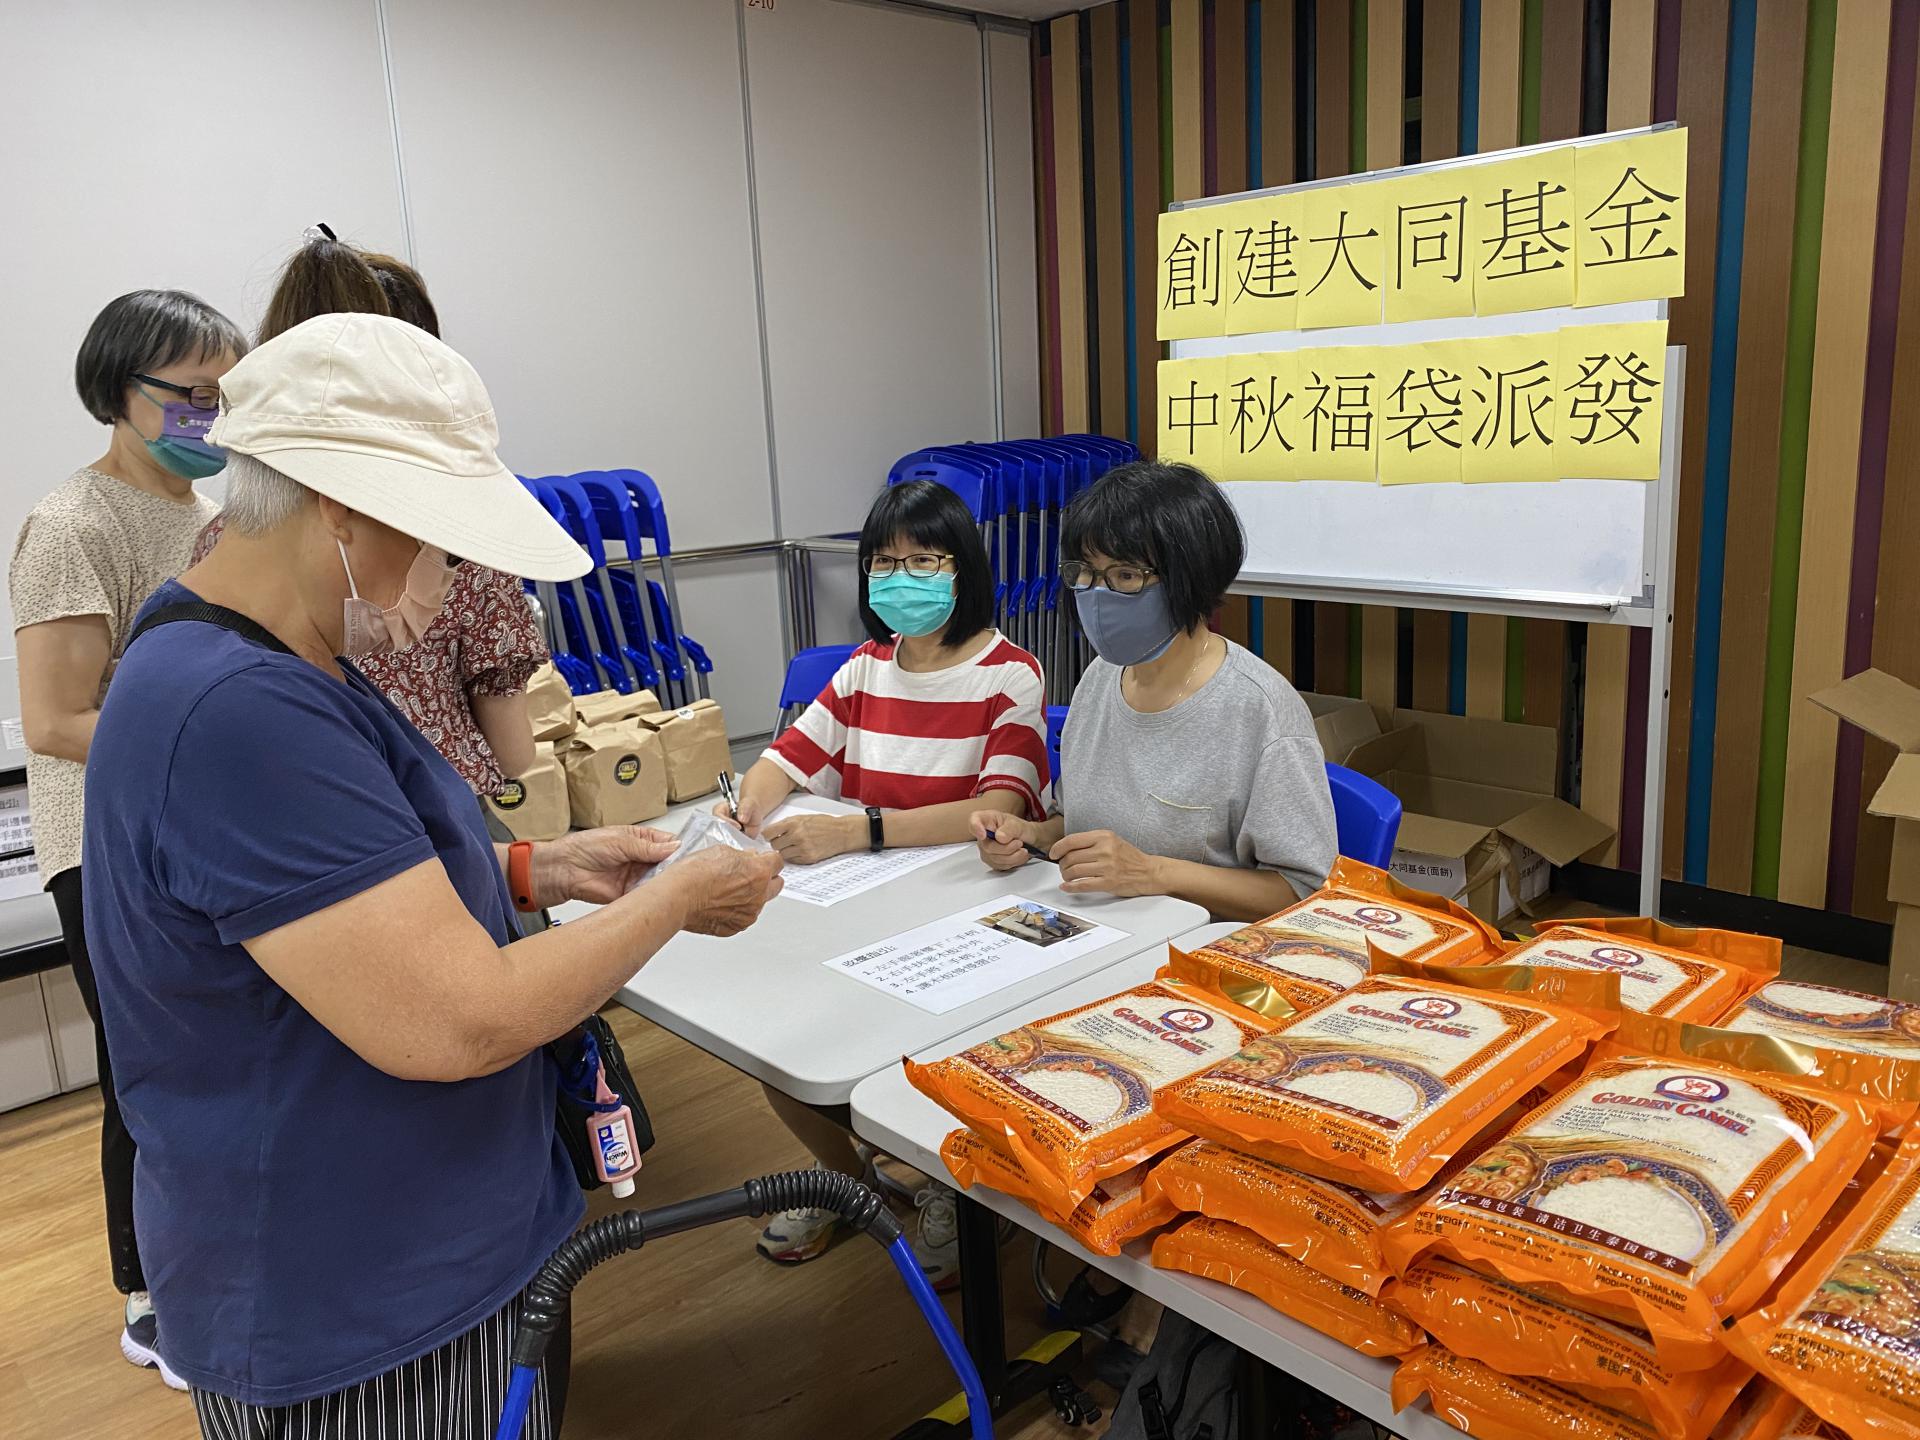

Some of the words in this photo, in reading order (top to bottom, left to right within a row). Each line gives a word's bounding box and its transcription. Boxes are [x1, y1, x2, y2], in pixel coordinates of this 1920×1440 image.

[1163, 166, 1680, 311] 創建大同基金
[1167, 351, 1662, 455] 中秋福袋派發
[1112, 1007, 1166, 1035] GOLDEN
[1160, 1031, 1208, 1056] CAMEL
[1347, 1005, 1416, 1026] GOLDEN
[1413, 1018, 1473, 1039] CAMEL
[1591, 1092, 1678, 1111] GOLDEN
[1675, 1102, 1748, 1136] CAMEL
[606, 1150, 628, 1162] Walch
[1309, 1188, 1335, 1206] PRODUCT
[1334, 1201, 1346, 1210] OF
[1417, 1210, 1435, 1219] NET
[1435, 1214, 1470, 1229] WEIGHT
[1579, 1336, 1613, 1356] PRODUIT
[1613, 1352, 1626, 1363] DE
[1620, 1344, 1634, 1354] OF
